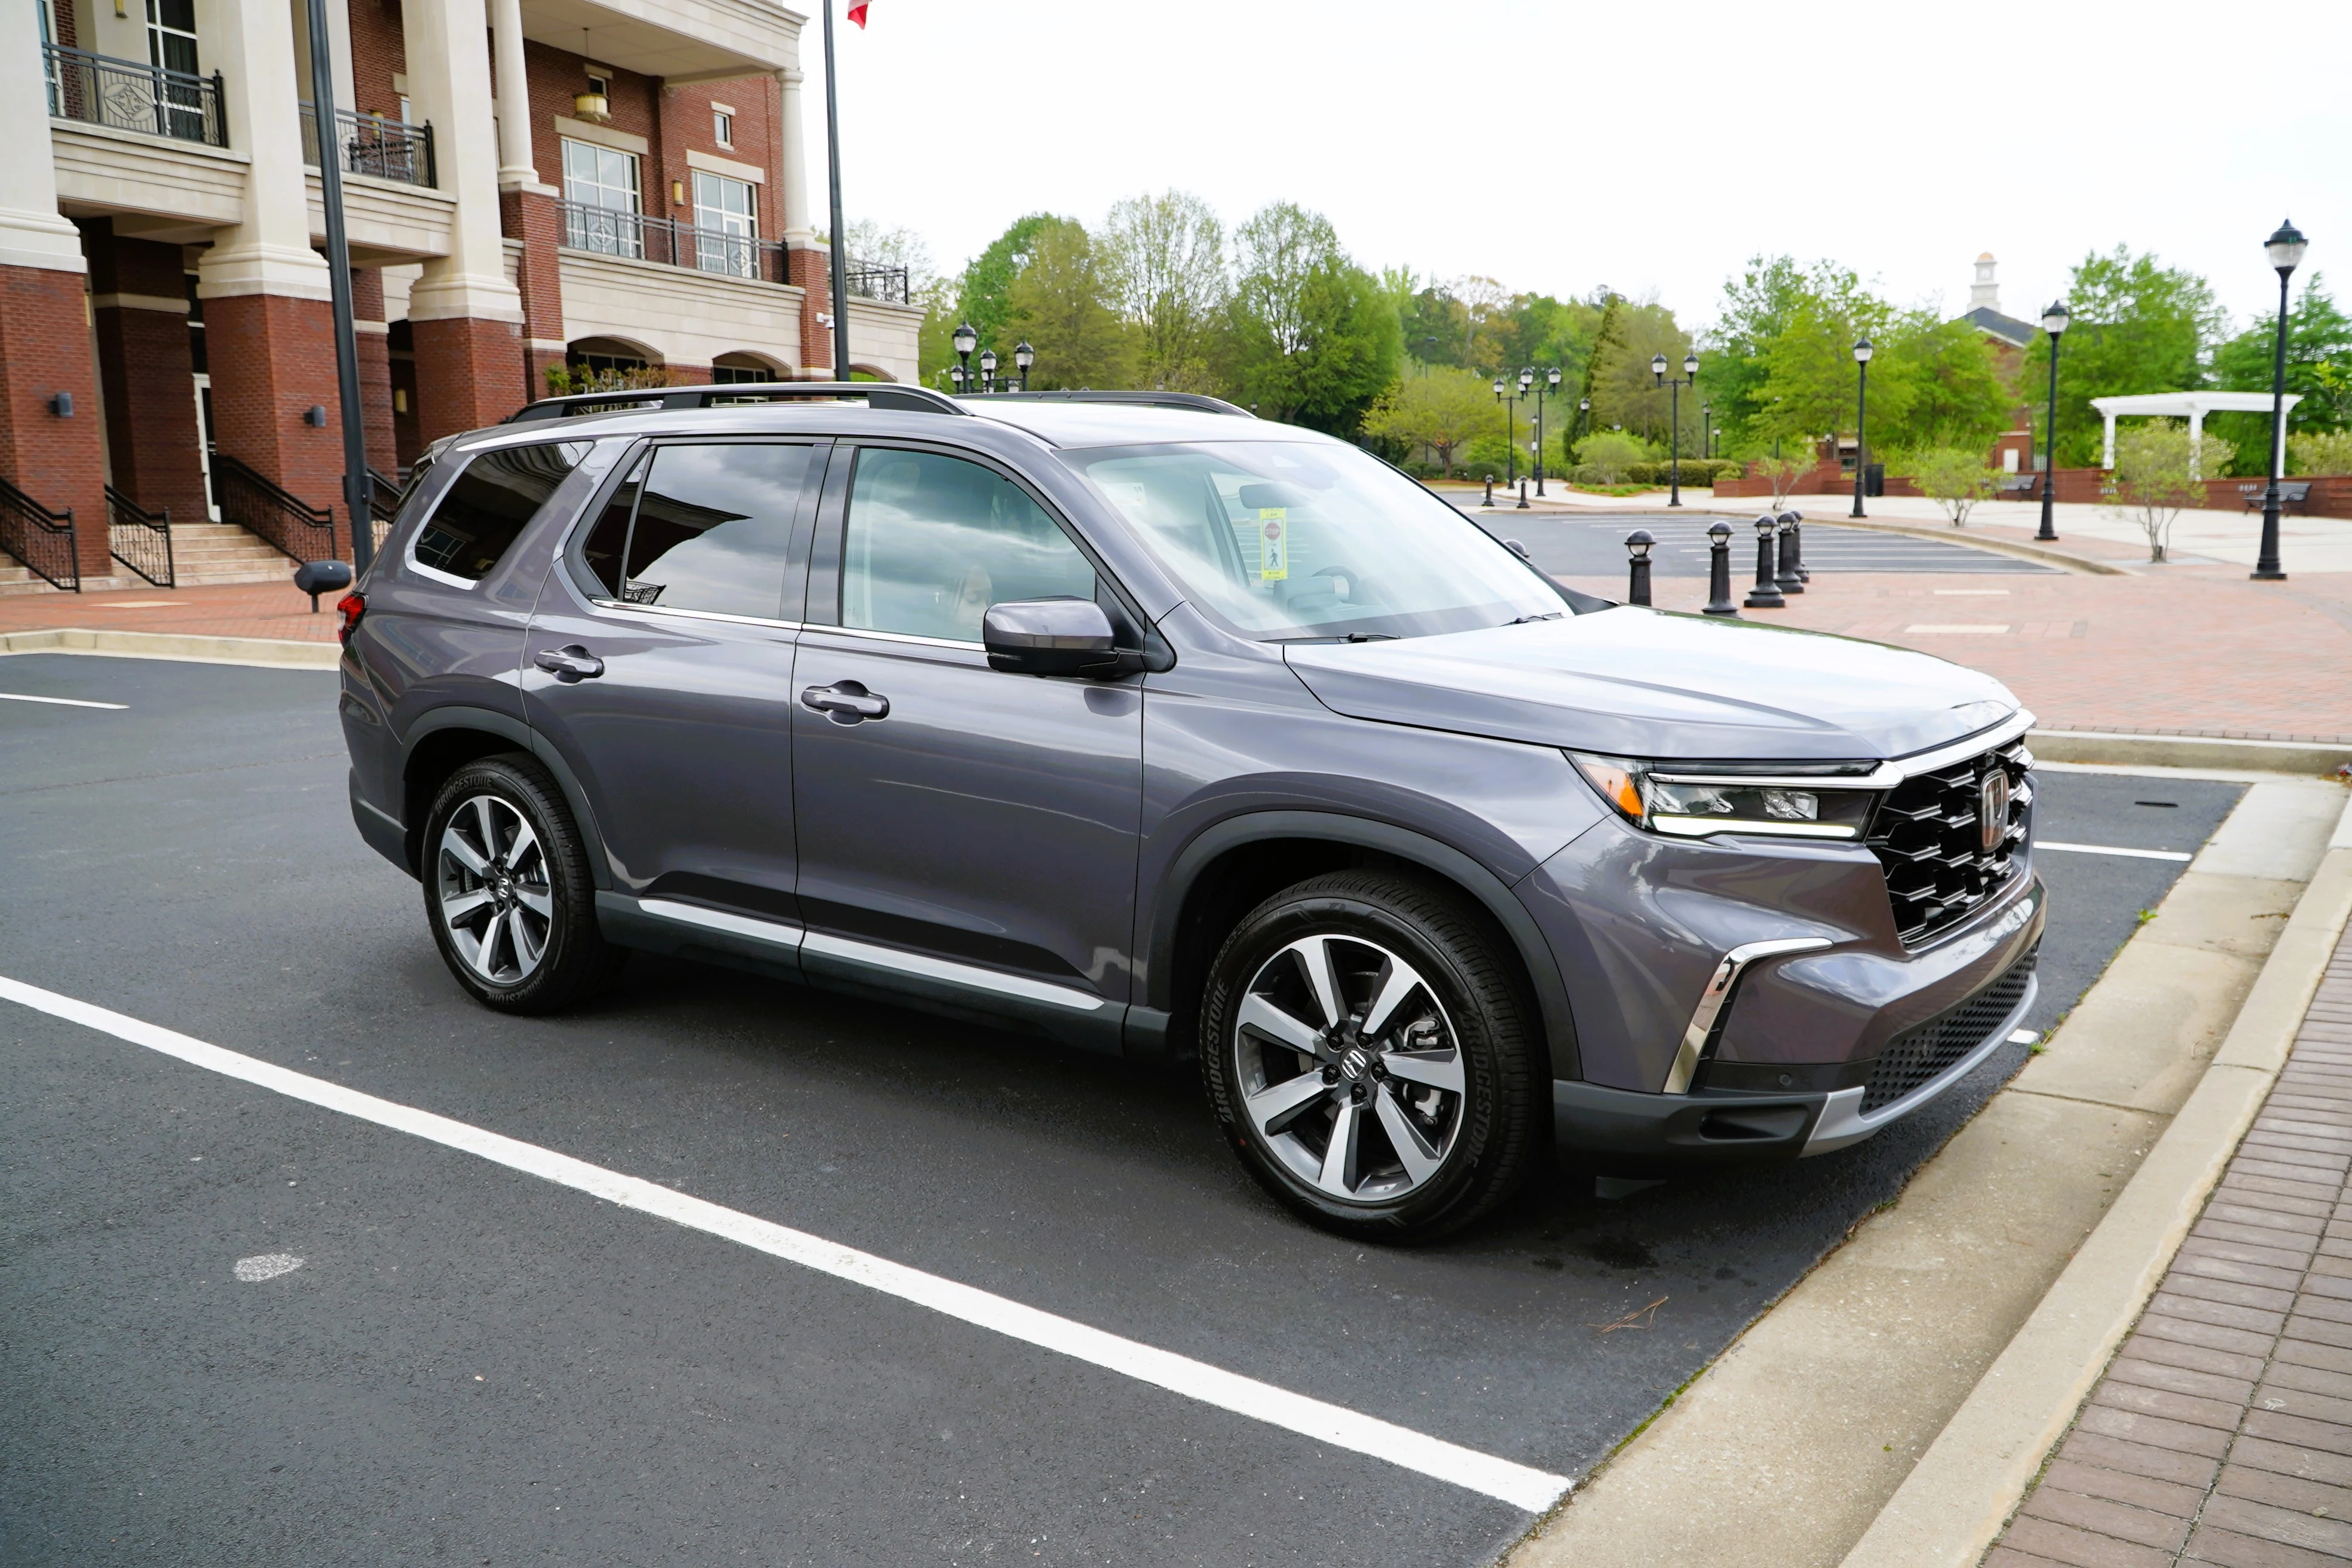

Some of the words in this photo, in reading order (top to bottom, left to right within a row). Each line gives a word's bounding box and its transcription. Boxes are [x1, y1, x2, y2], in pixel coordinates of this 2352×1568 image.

[435, 775, 492, 816] BRIDGESTONE
[1207, 978, 1236, 1123] BRIDGESTONE
[1460, 1010, 1492, 1168] BRIDGESTONE
